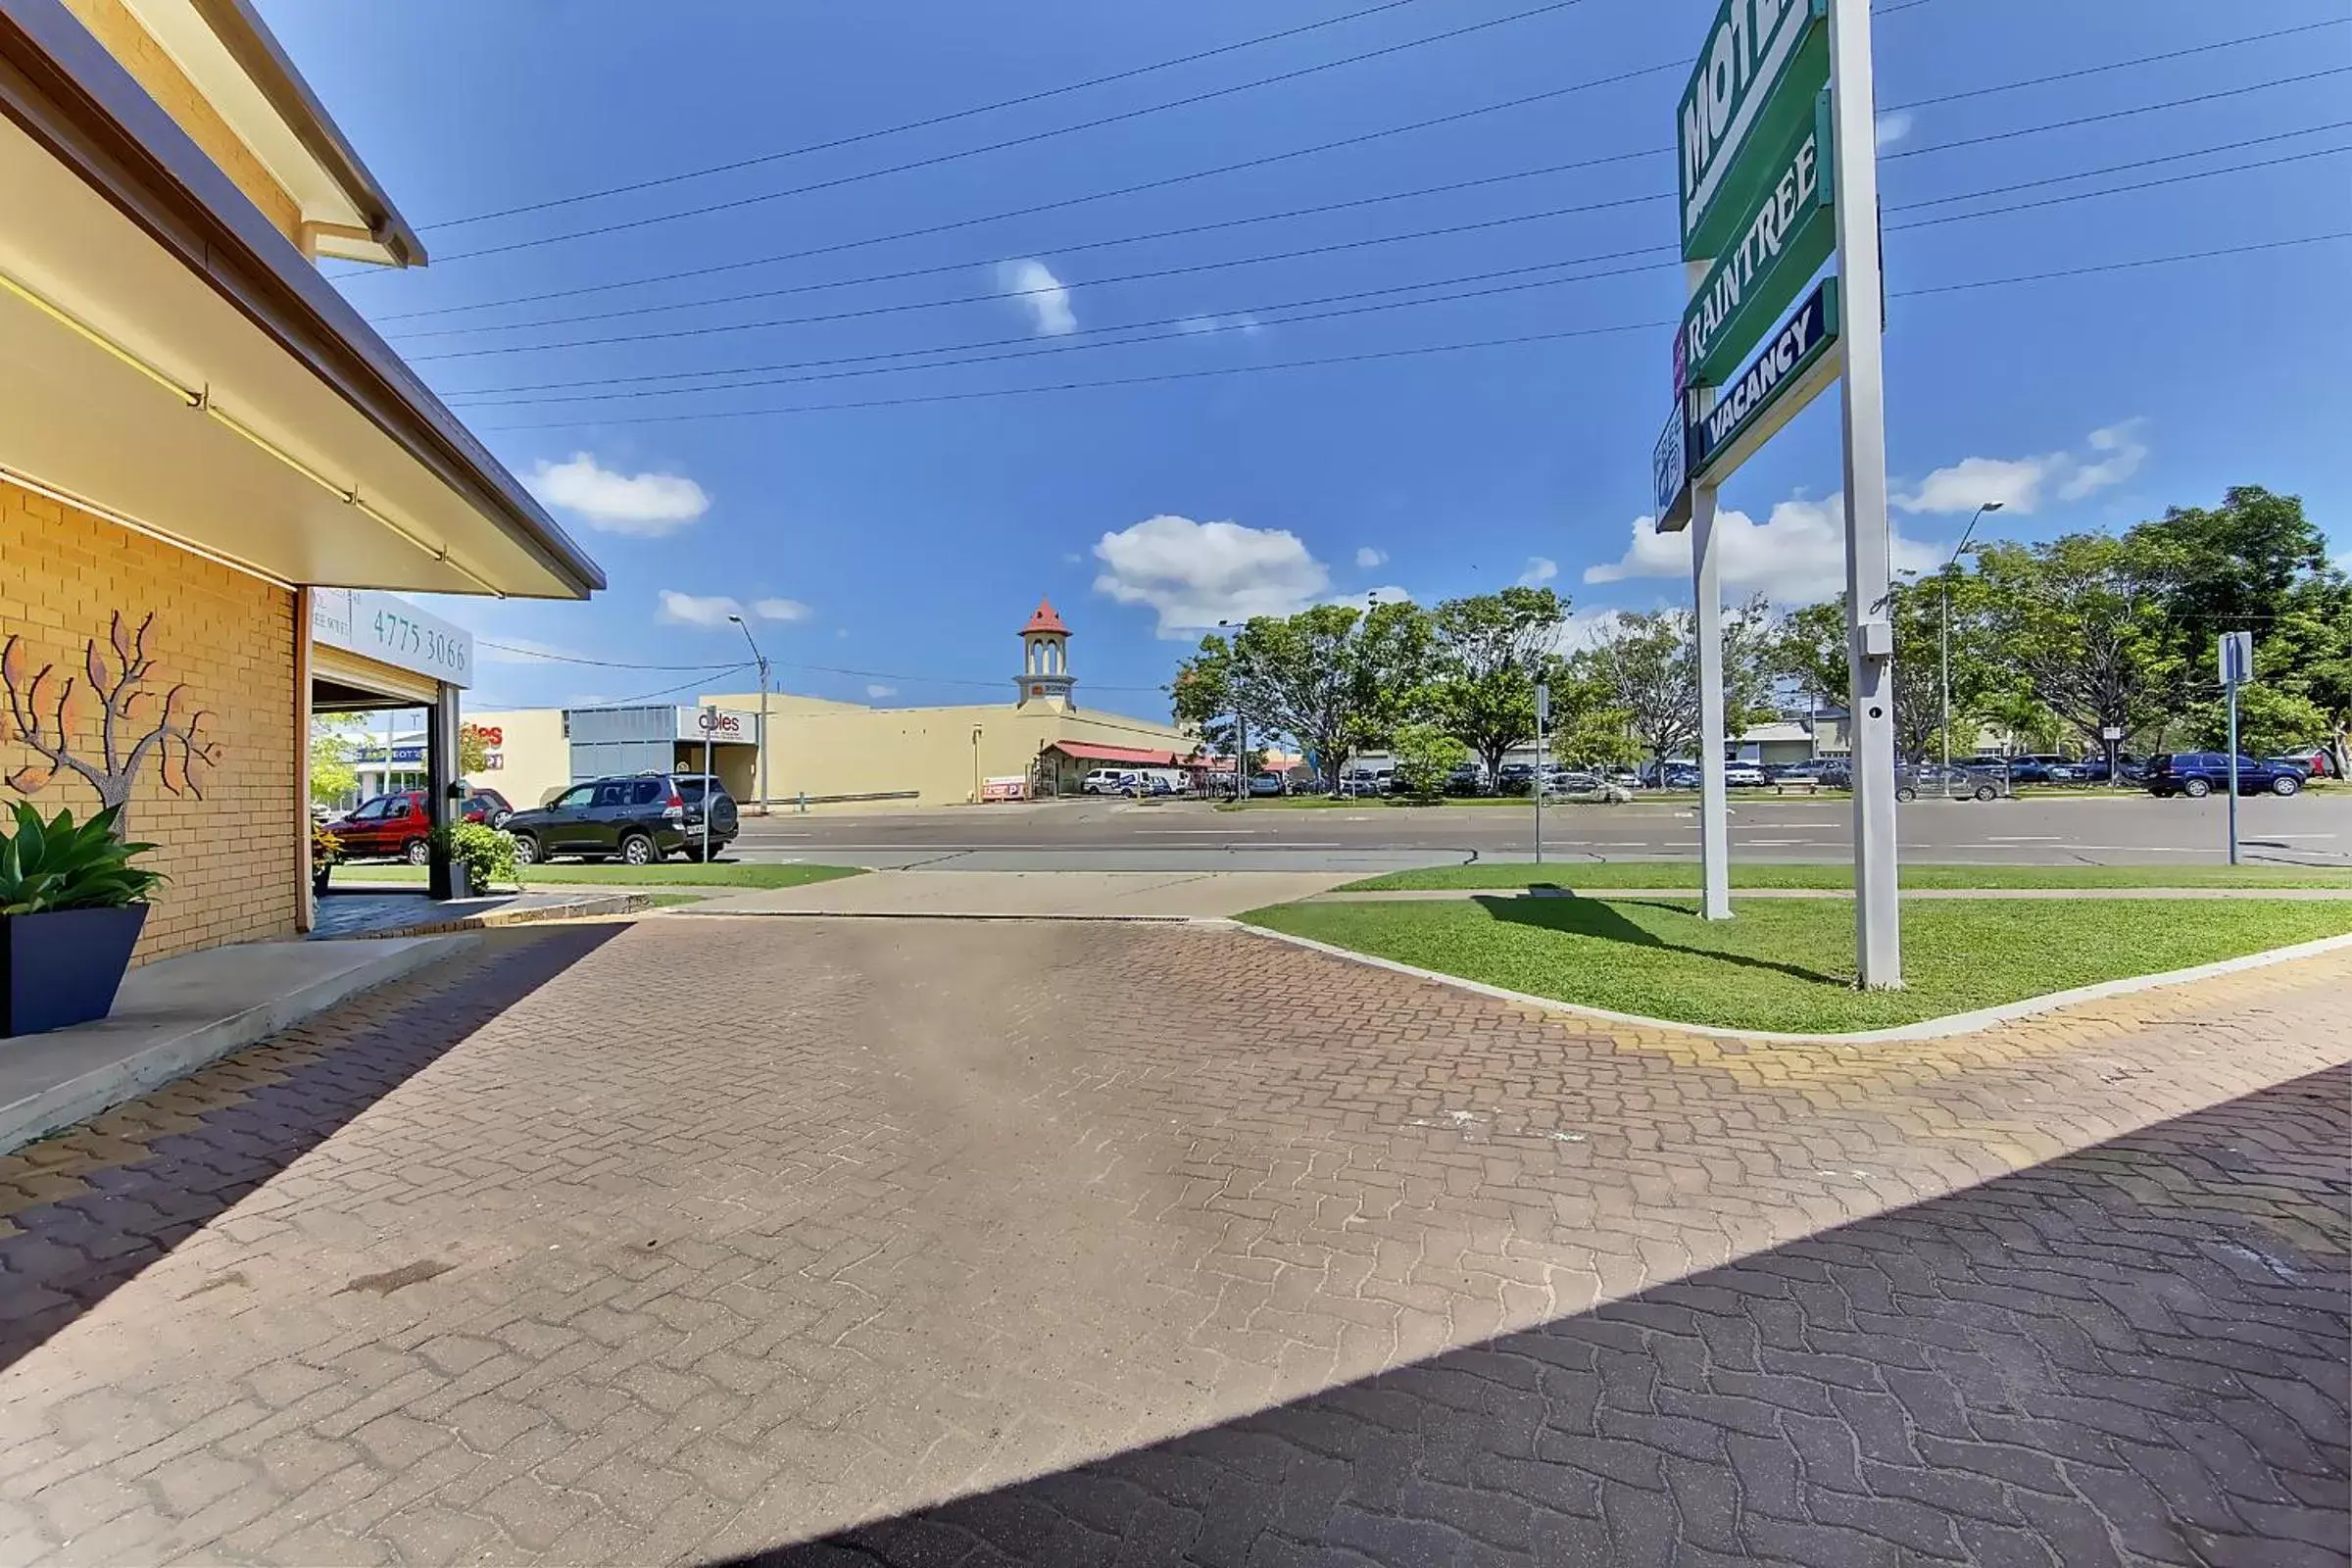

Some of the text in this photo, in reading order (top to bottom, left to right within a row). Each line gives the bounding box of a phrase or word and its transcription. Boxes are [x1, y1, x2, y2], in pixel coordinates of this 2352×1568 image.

[1684, 0, 1787, 200] MOTE
[1688, 133, 1817, 365] RAINTREE
[1708, 305, 1813, 445] VACANCY
[373, 609, 466, 671] 4775 3066
